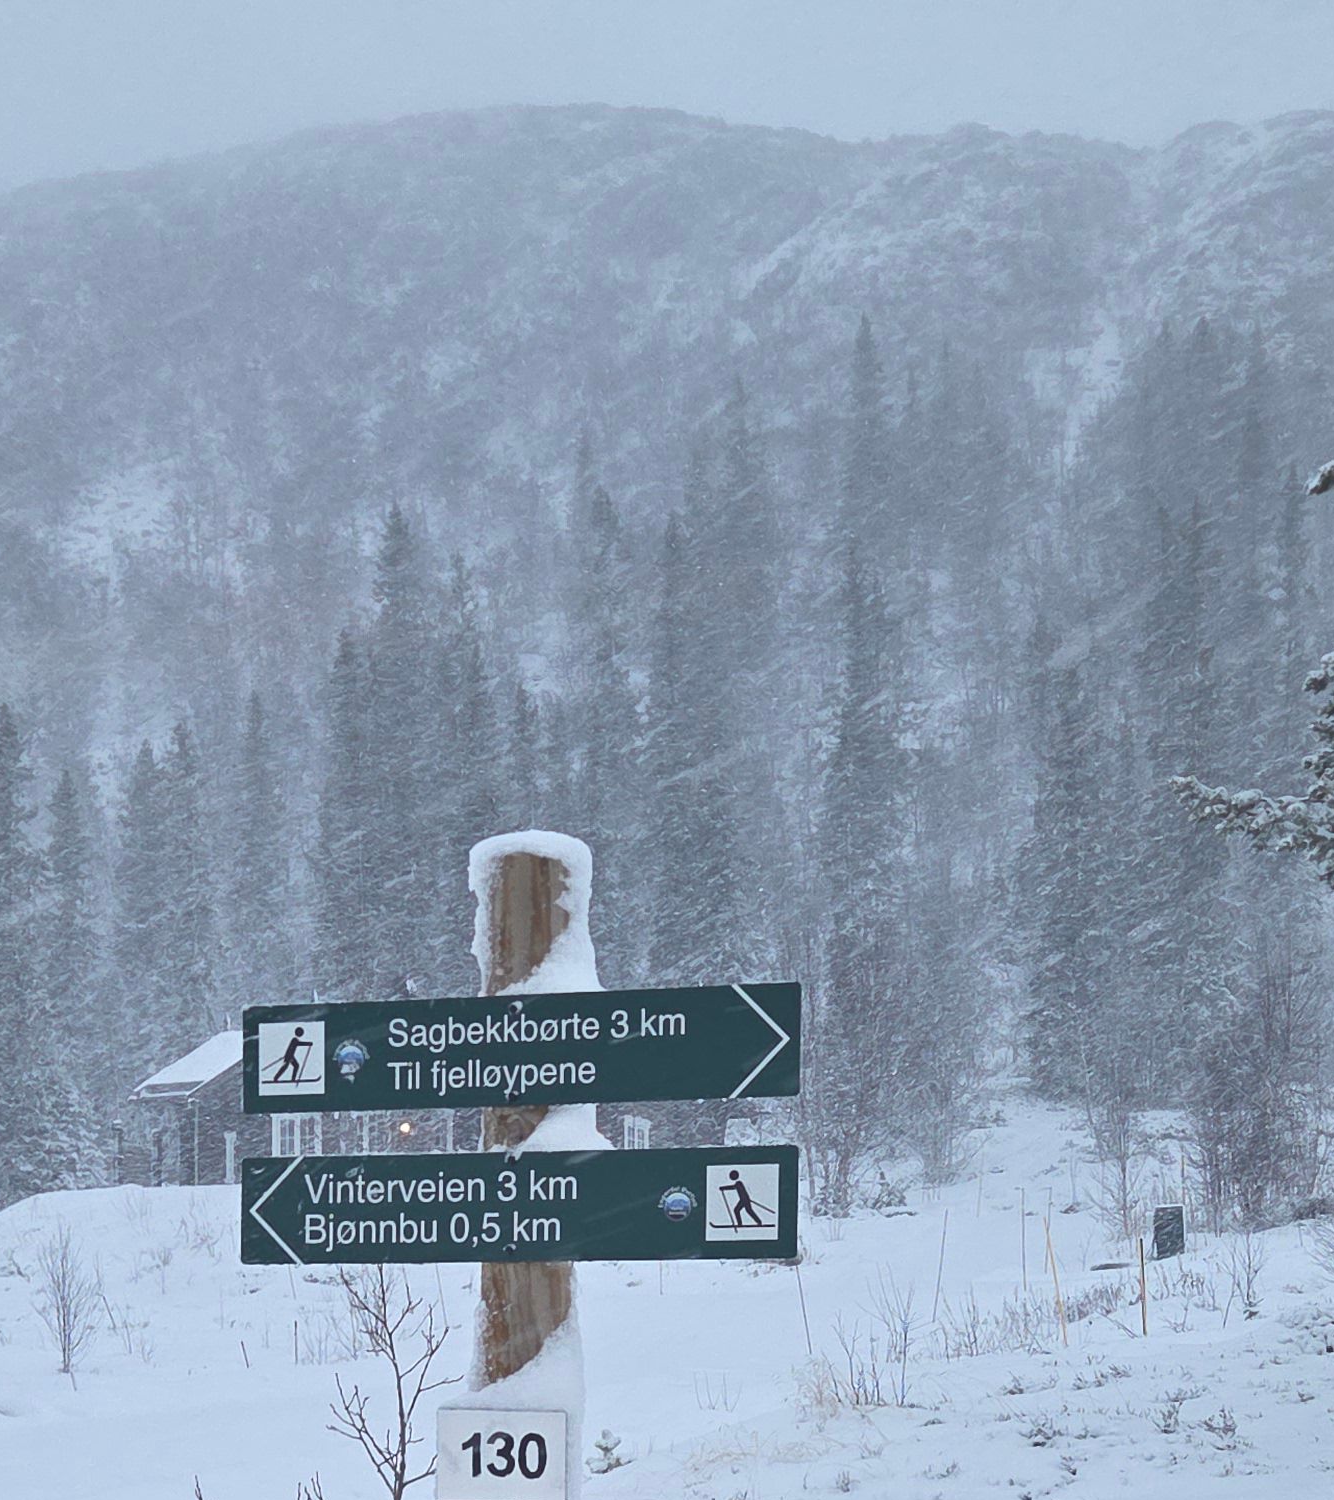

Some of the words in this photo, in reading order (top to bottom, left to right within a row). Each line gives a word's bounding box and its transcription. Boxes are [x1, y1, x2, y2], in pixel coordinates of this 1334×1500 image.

[388, 1013, 600, 1053] Sagbekkbørte
[610, 1009, 630, 1039] 3
[640, 1008, 686, 1038] km
[387, 1061, 421, 1090] Til
[431, 1059, 596, 1097] fjelløypene
[304, 1171, 486, 1205] Vinterveien
[497, 1170, 517, 1202] 3
[529, 1169, 578, 1201] km
[304, 1212, 438, 1252] Bjønnbu
[450, 1212, 501, 1248] 0,5
[513, 1210, 561, 1242] km
[462, 1431, 548, 1480] 130
